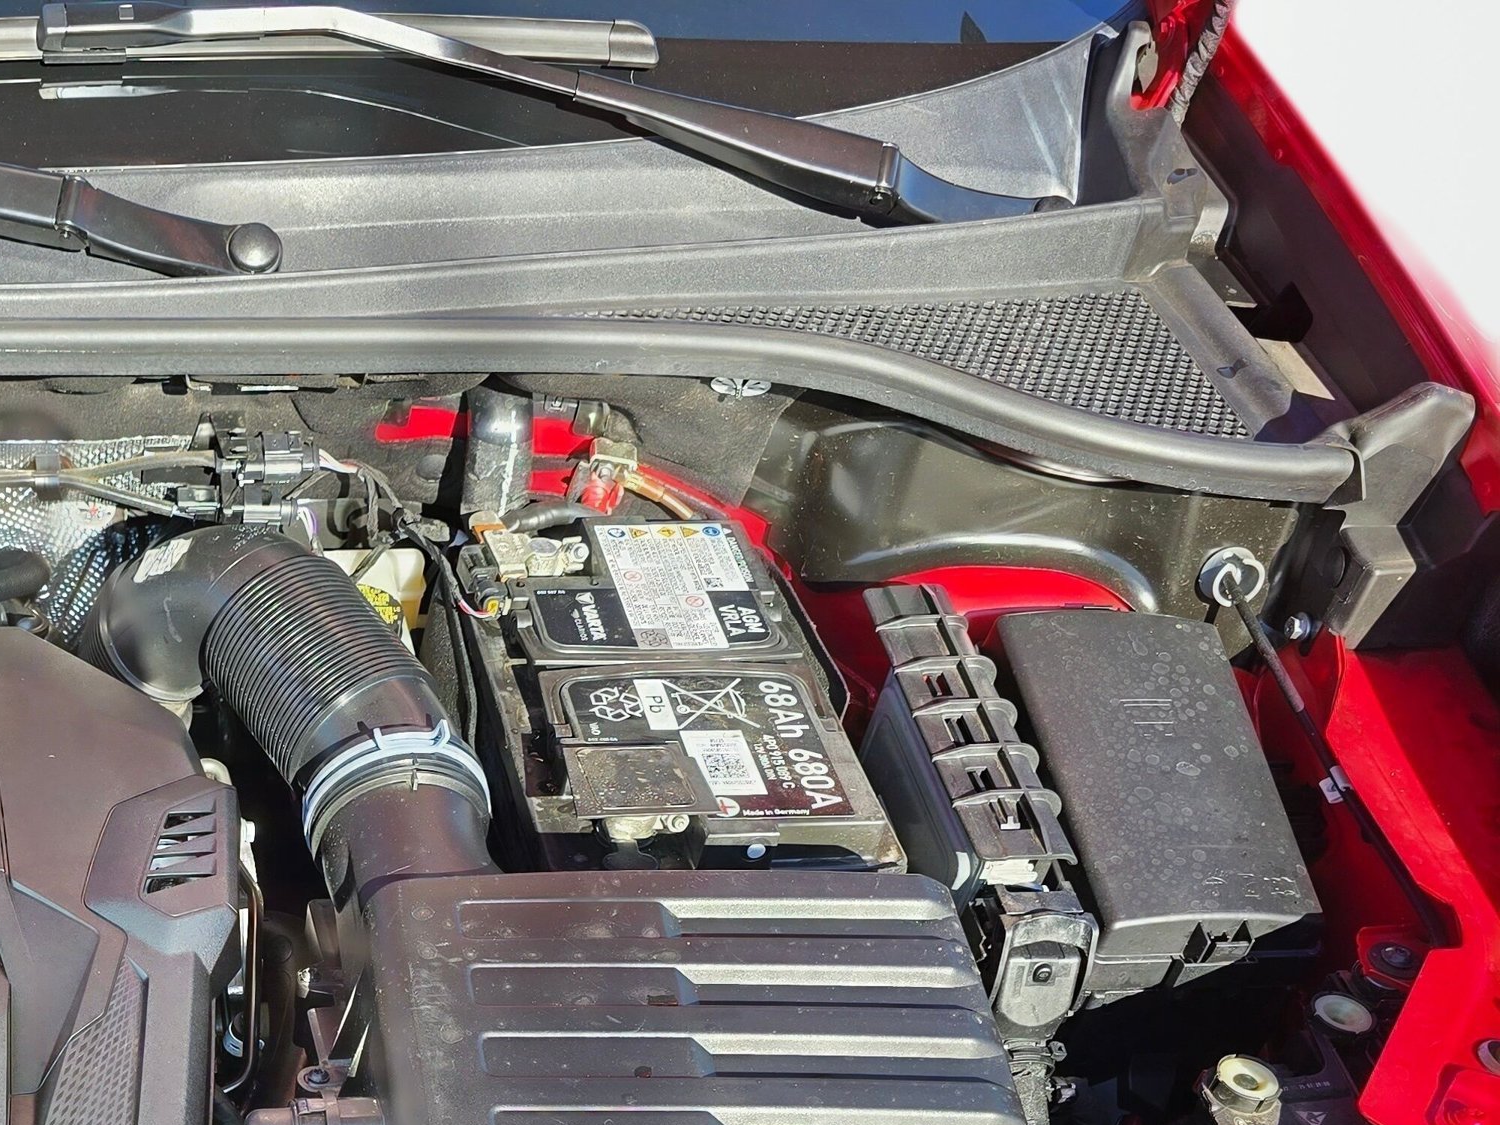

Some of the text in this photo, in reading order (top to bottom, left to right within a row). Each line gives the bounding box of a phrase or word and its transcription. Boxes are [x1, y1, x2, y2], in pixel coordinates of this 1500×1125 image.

[581, 604, 606, 641] VARTA
[718, 604, 746, 637] VRLA
[737, 606, 766, 633] AGM
[645, 696, 665, 713] Pb
[758, 680, 843, 810] 68Ah 680A
[769, 750, 795, 790] 915 C
[742, 808, 810, 817] Made in Germany
